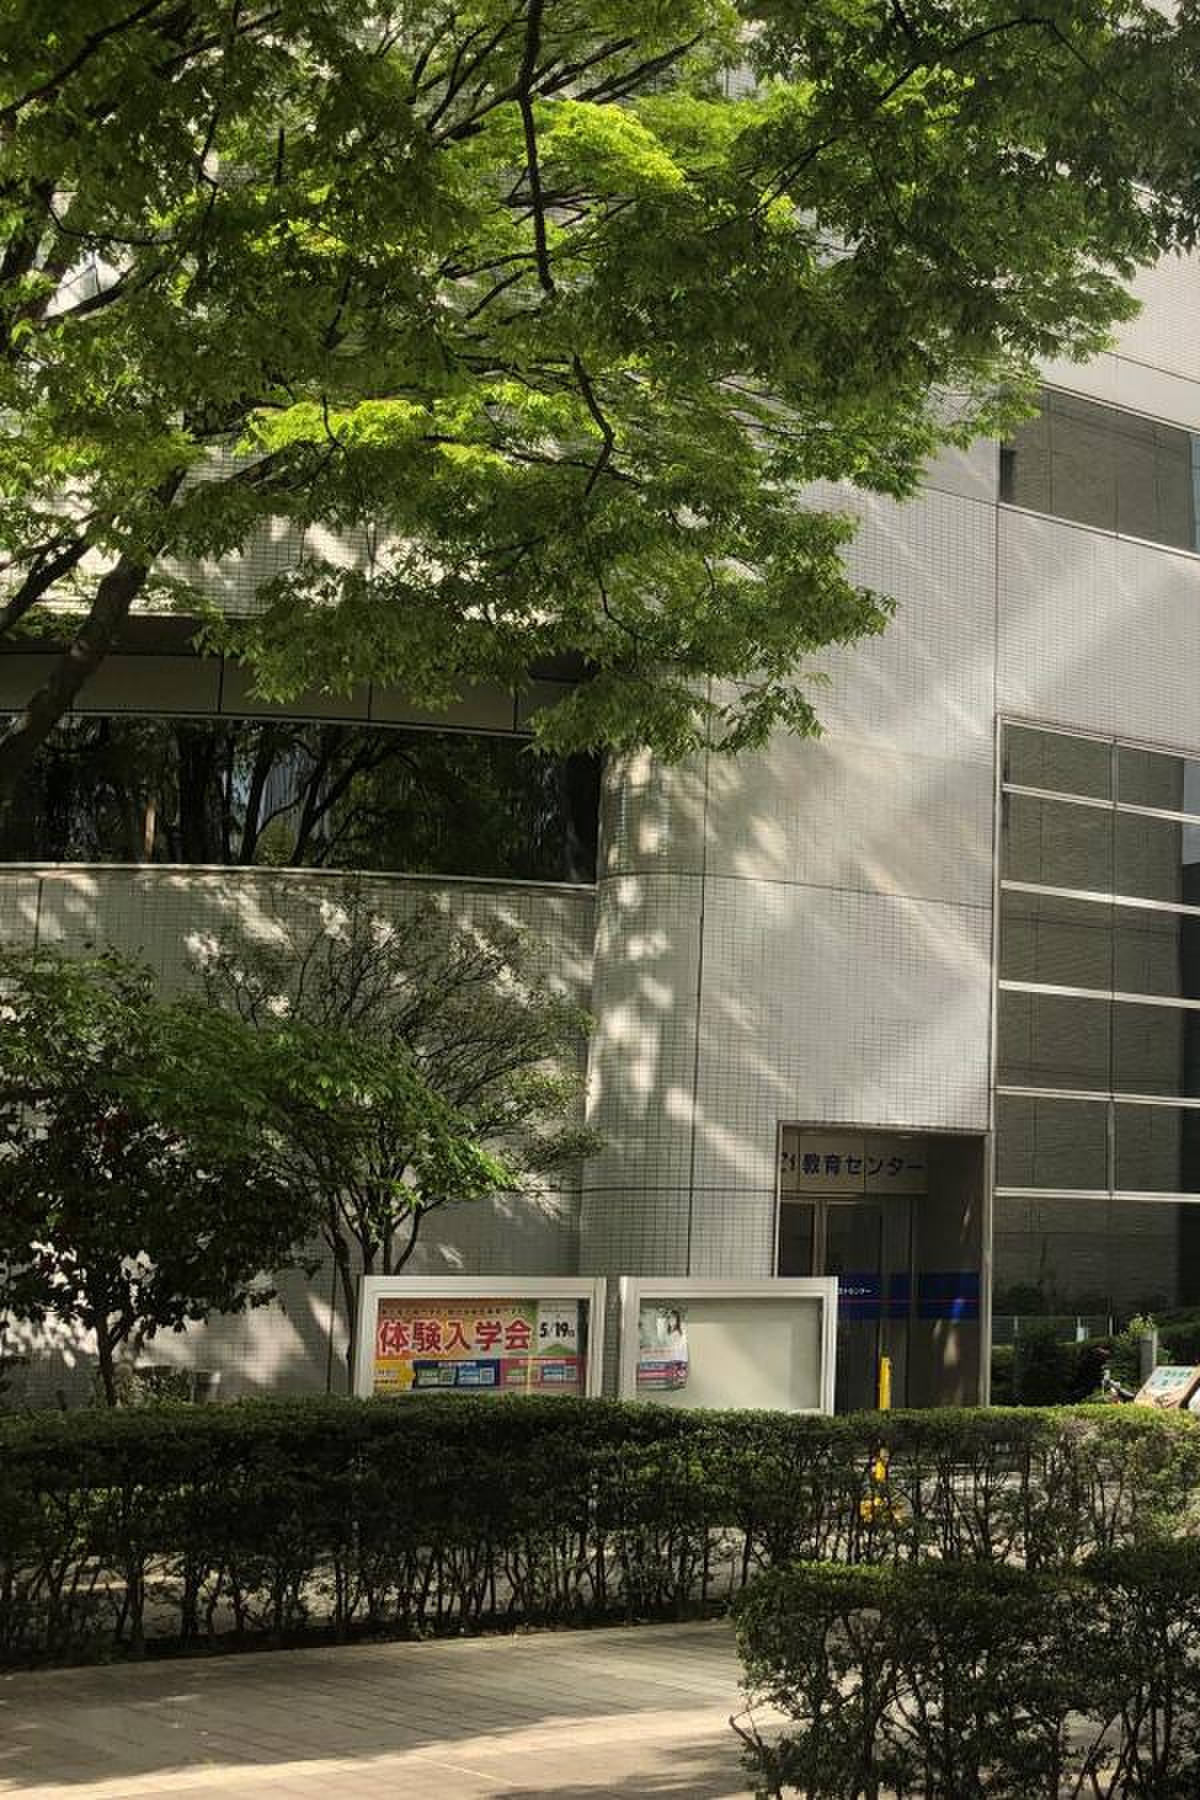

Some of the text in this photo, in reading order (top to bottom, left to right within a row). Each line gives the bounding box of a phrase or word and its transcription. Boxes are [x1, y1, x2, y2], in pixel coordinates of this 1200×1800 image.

[379, 1319, 532, 1353] 体験入学会
